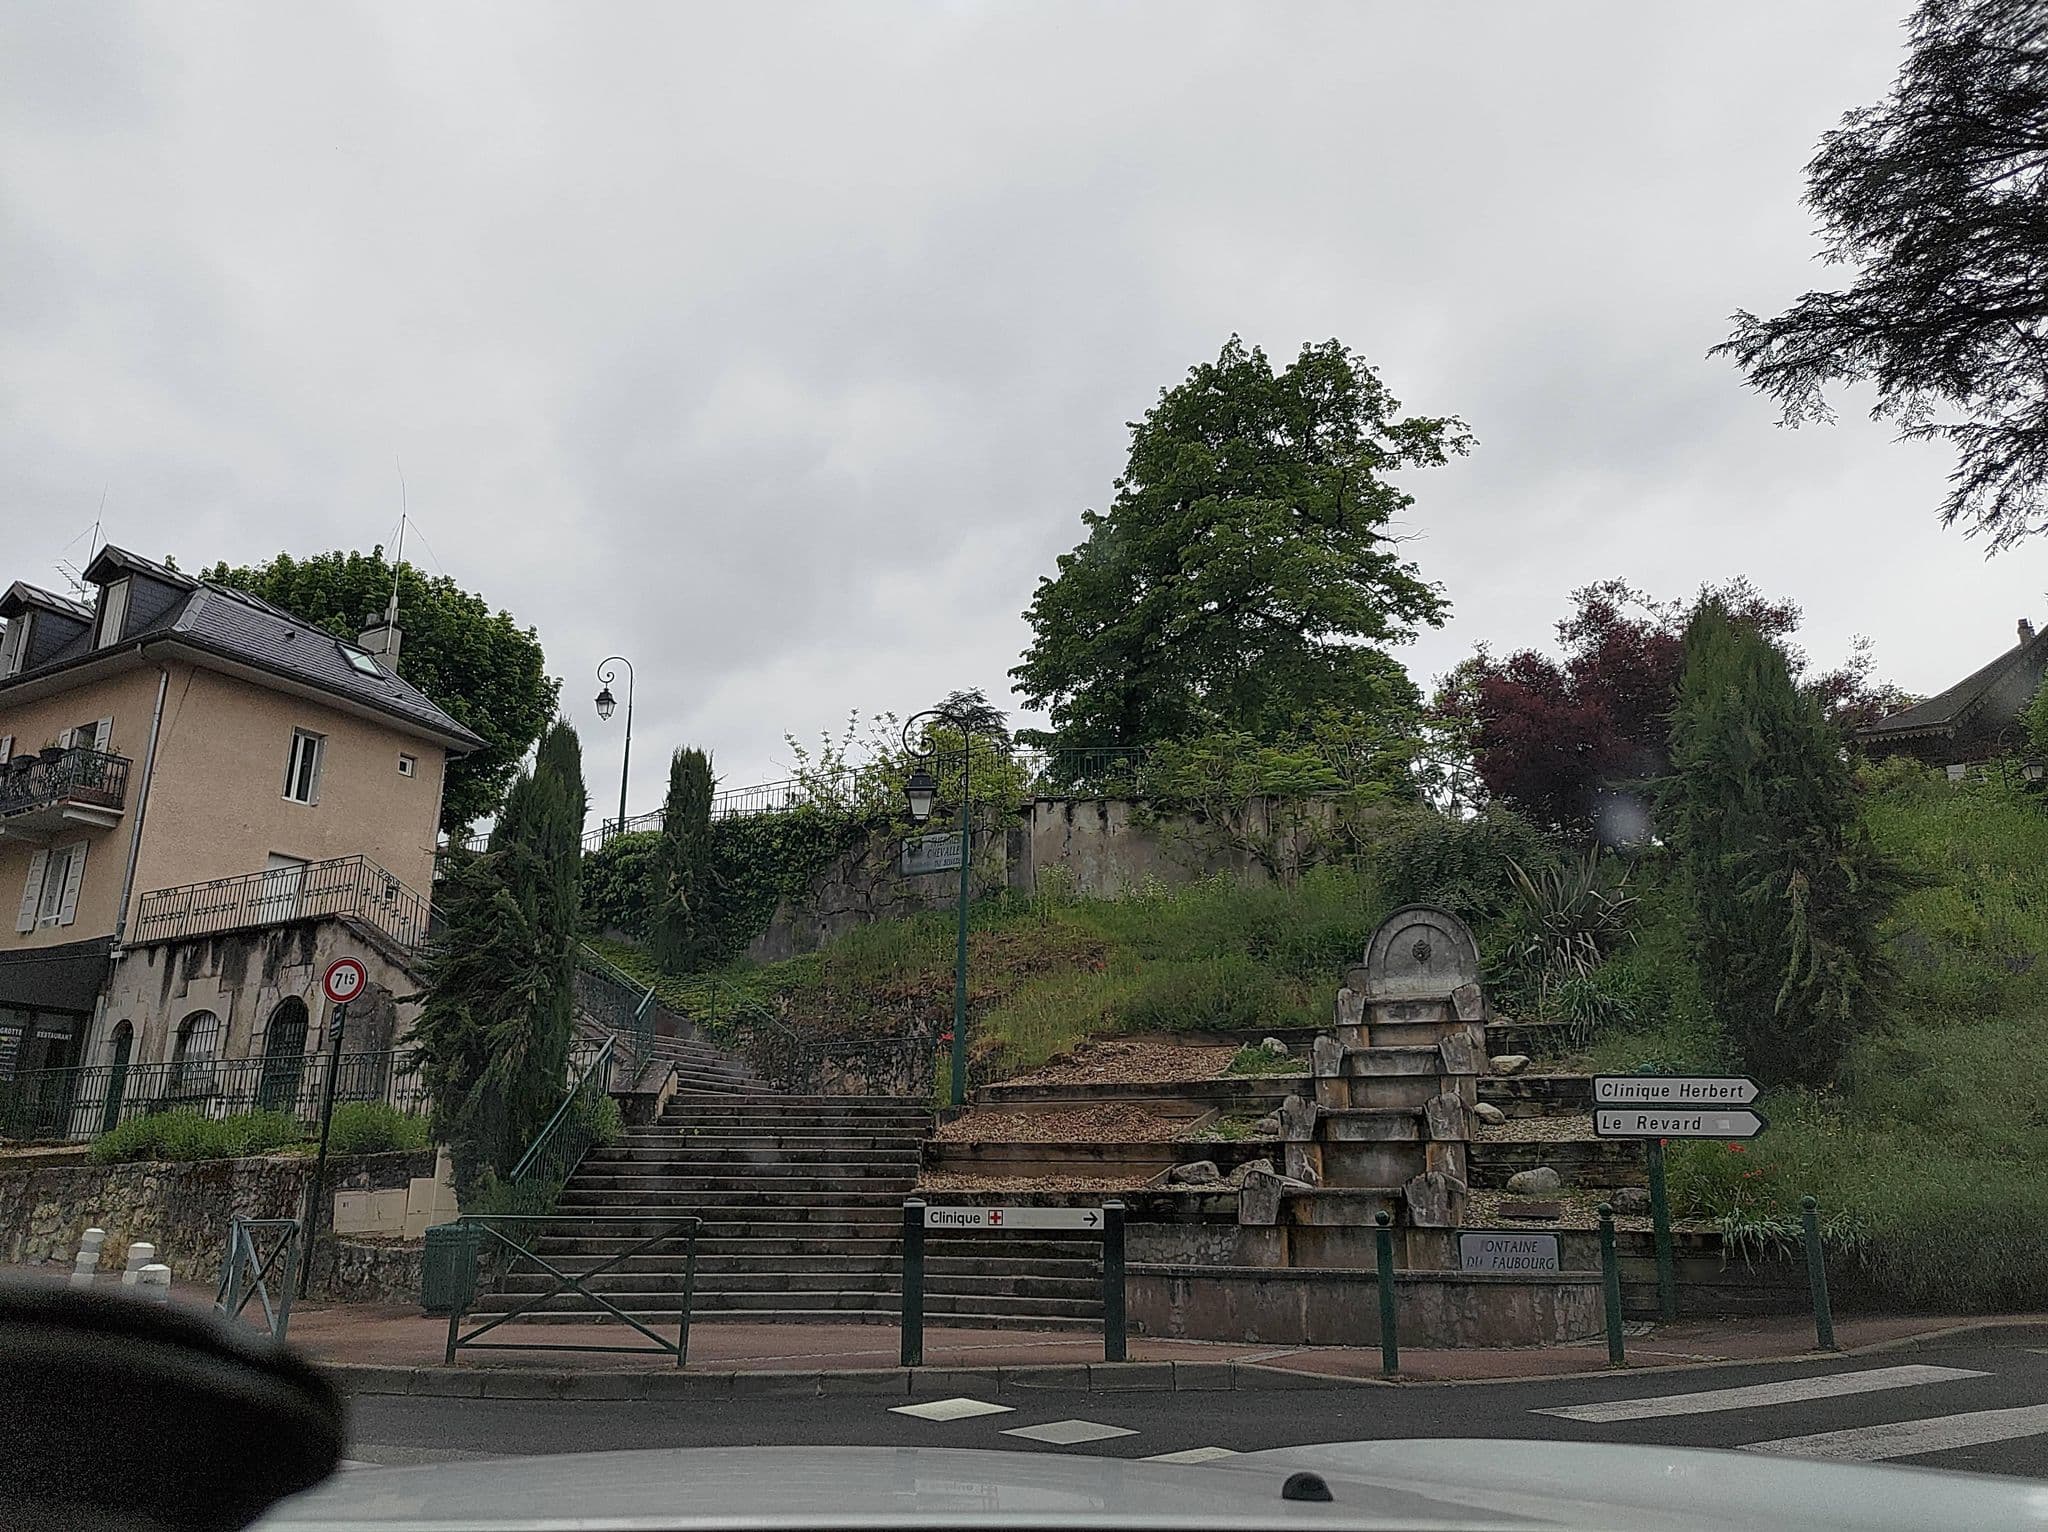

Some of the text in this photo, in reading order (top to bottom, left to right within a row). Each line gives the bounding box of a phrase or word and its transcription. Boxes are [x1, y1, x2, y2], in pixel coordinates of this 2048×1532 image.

[36, 1031, 73, 1041] RESTAURANT
[1601, 1083, 1744, 1100] Clinique Herbert
[1602, 1115, 1702, 1130] Le Revard
[930, 1211, 981, 1226] Clinique
[1492, 1256, 1555, 1270] FAUBOURG
